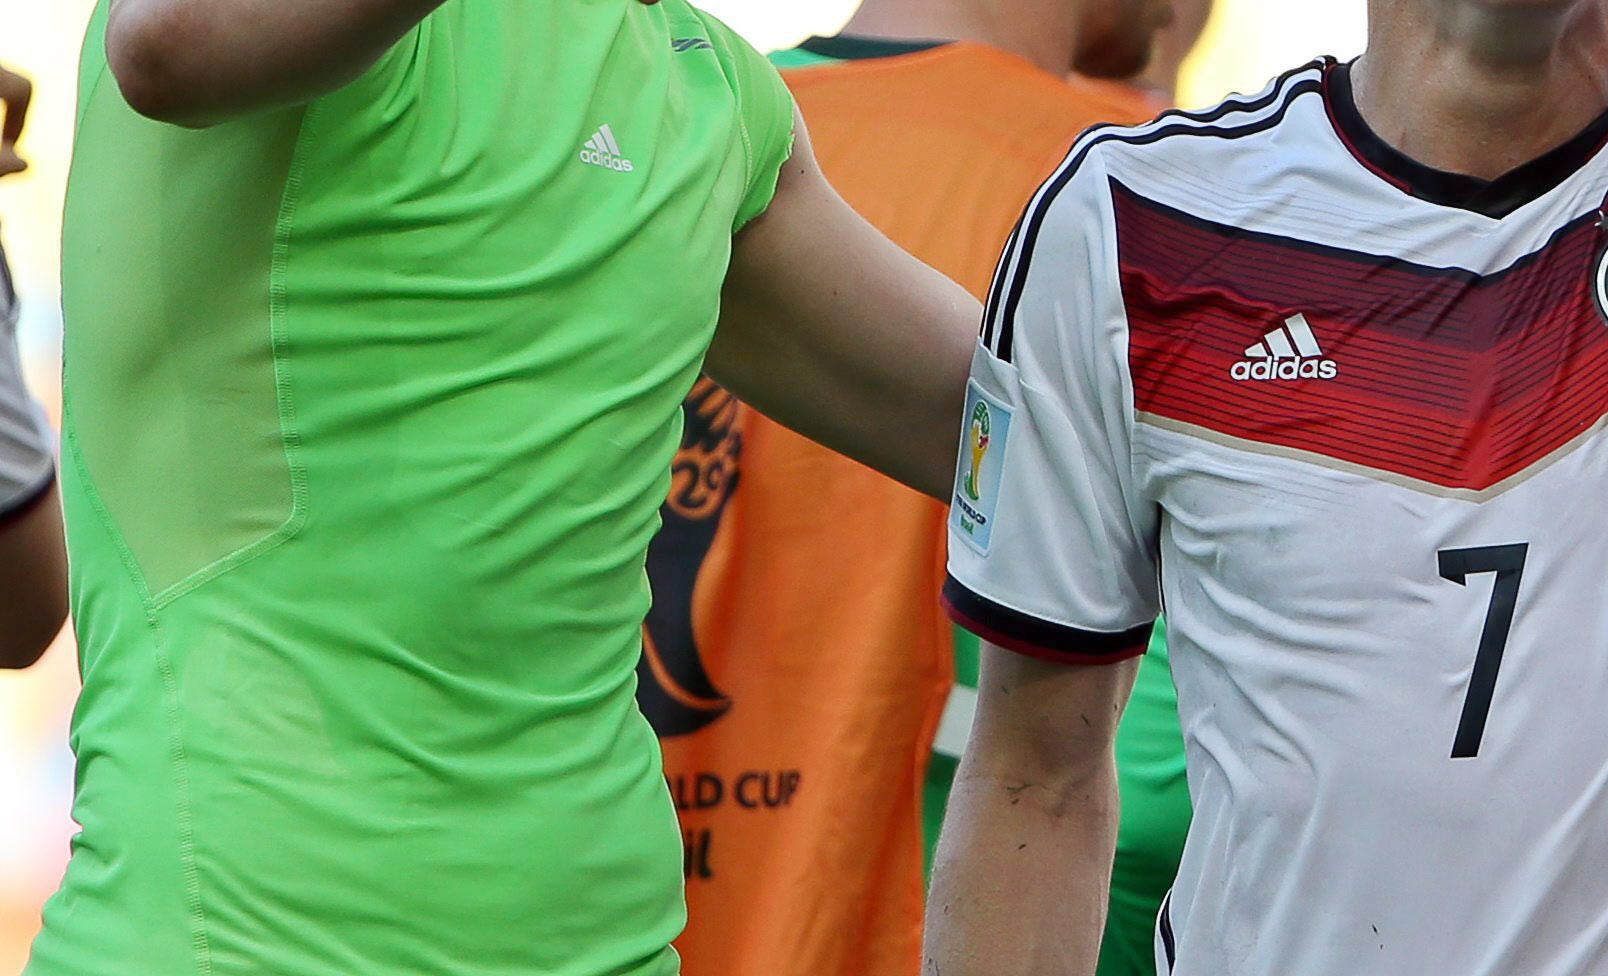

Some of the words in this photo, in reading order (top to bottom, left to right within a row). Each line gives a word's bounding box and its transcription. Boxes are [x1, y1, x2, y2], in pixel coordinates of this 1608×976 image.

[580, 150, 633, 172] adidas
[1230, 355, 1338, 381] adidas
[1437, 541, 1530, 759] 7
[735, 768, 801, 809] CUP
